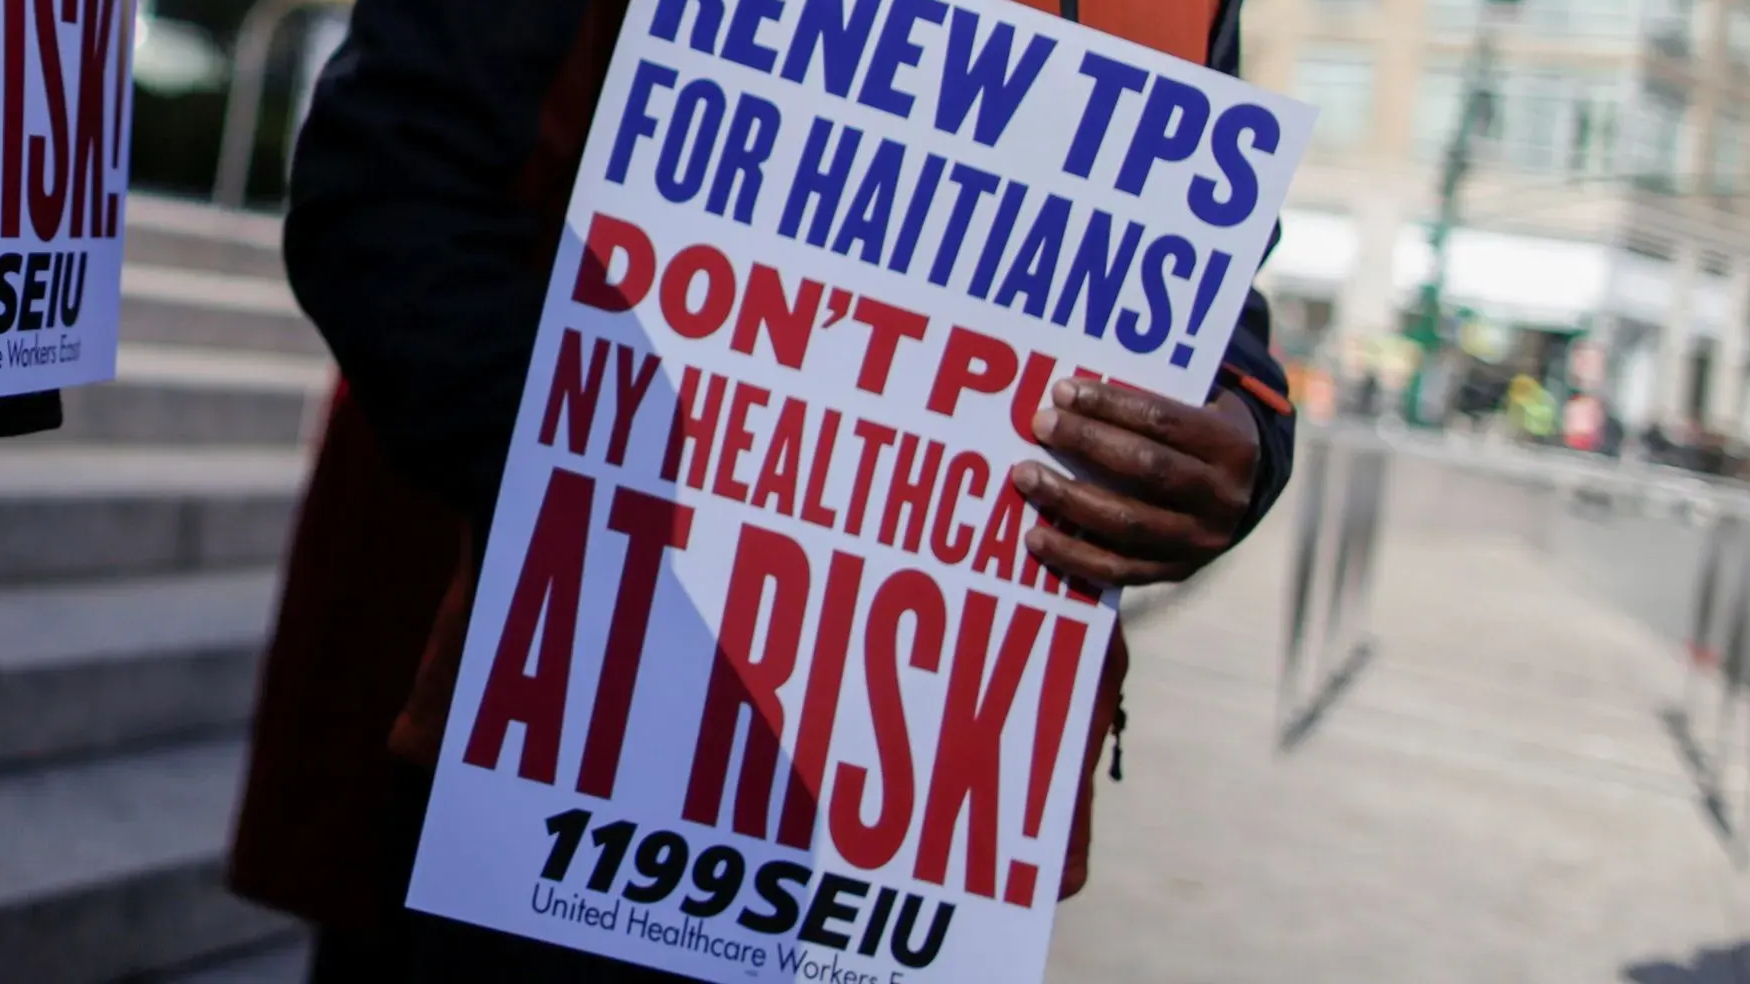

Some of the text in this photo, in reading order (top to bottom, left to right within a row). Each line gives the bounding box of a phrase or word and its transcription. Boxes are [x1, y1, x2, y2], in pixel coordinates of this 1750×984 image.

[604, 59, 1232, 370] FOR HAITIANS!
[1063, 50, 1281, 228] TPS
[7, 332, 56, 367] Workers
[570, 211, 1153, 446] DON'T PU
[538, 328, 1104, 608] NY HEALTHCA
[462, 467, 1089, 909] AT RISK!
[531, 882, 622, 932] United
[626, 905, 768, 968] Healthcare
[539, 808, 956, 970] 1199SEIU
